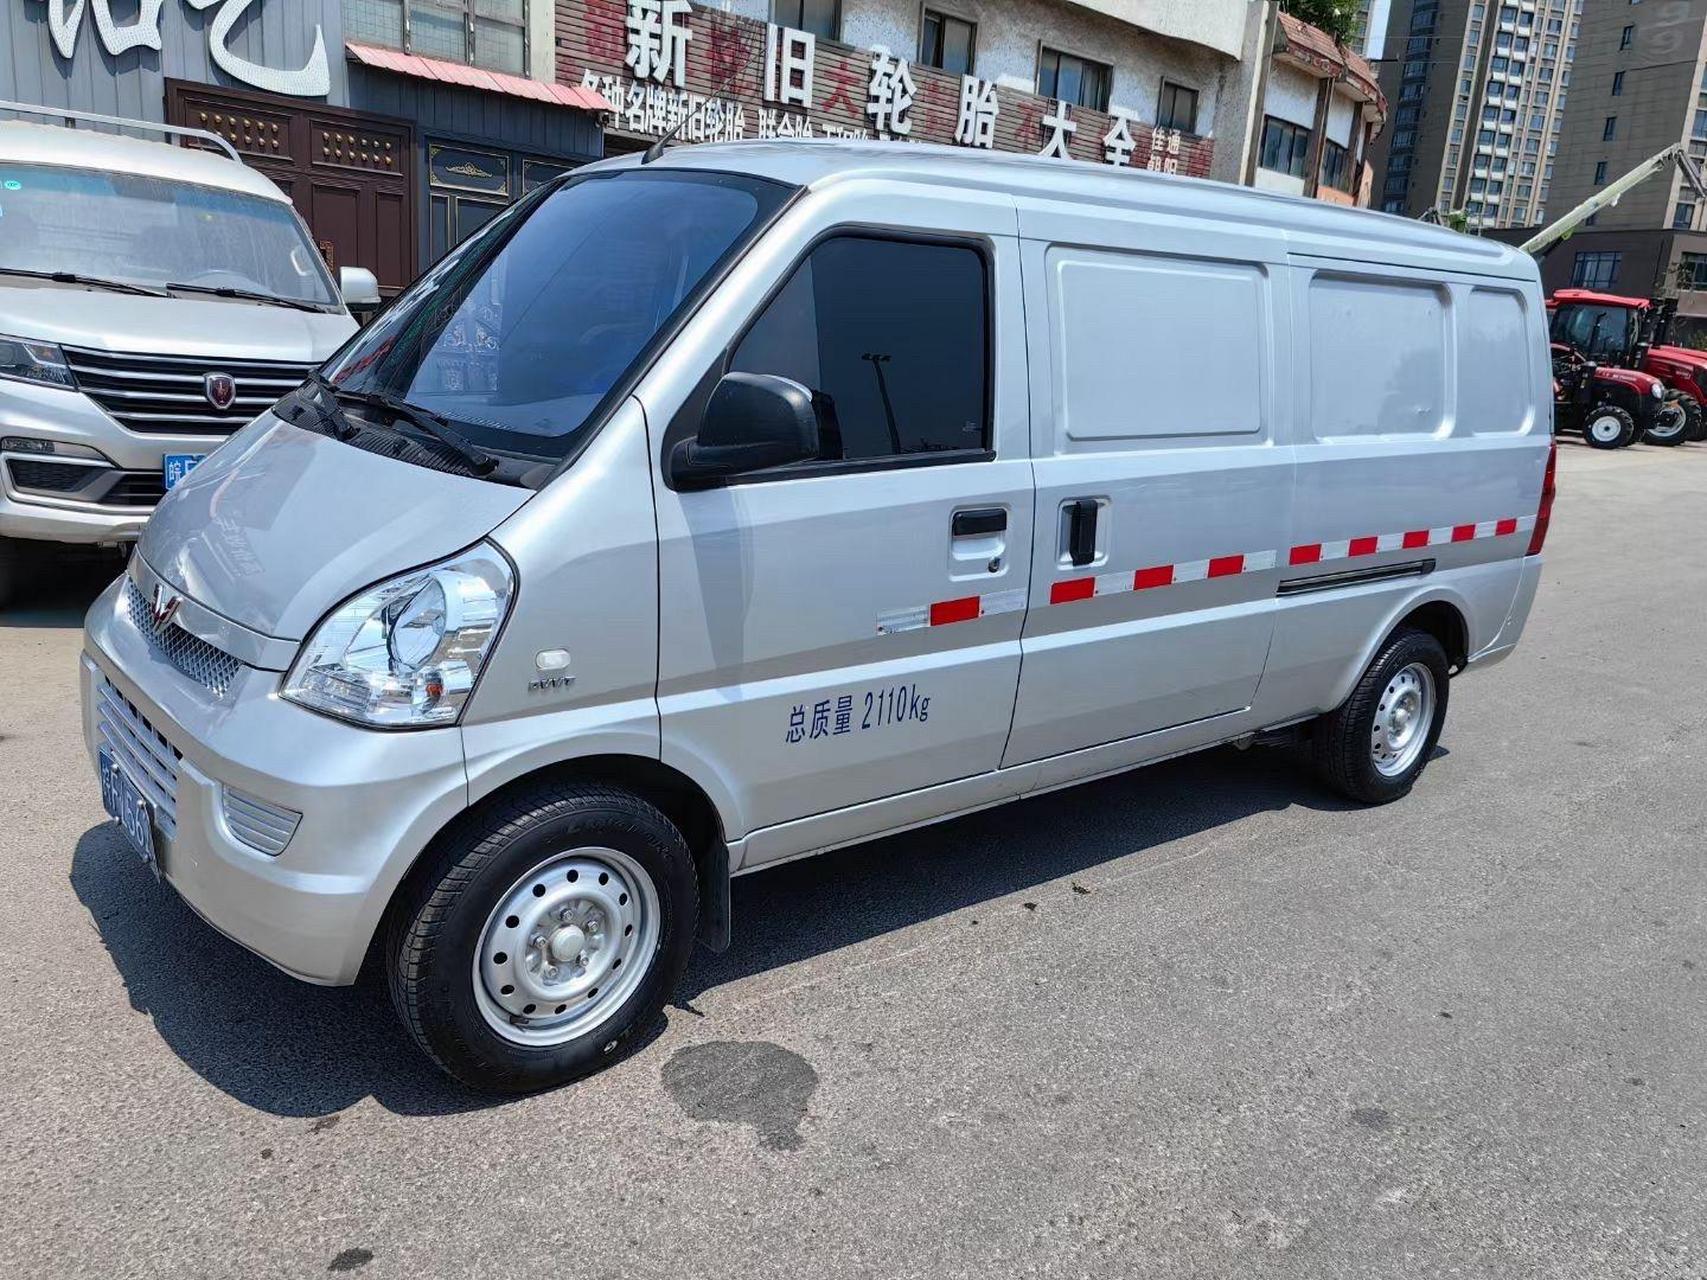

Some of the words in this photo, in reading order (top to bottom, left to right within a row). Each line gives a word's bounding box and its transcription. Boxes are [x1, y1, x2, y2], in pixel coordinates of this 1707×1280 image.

[625, 0, 1138, 168] 新旧轮胎大全
[785, 695, 853, 743] 总质量
[861, 683, 931, 731] 2110kg
